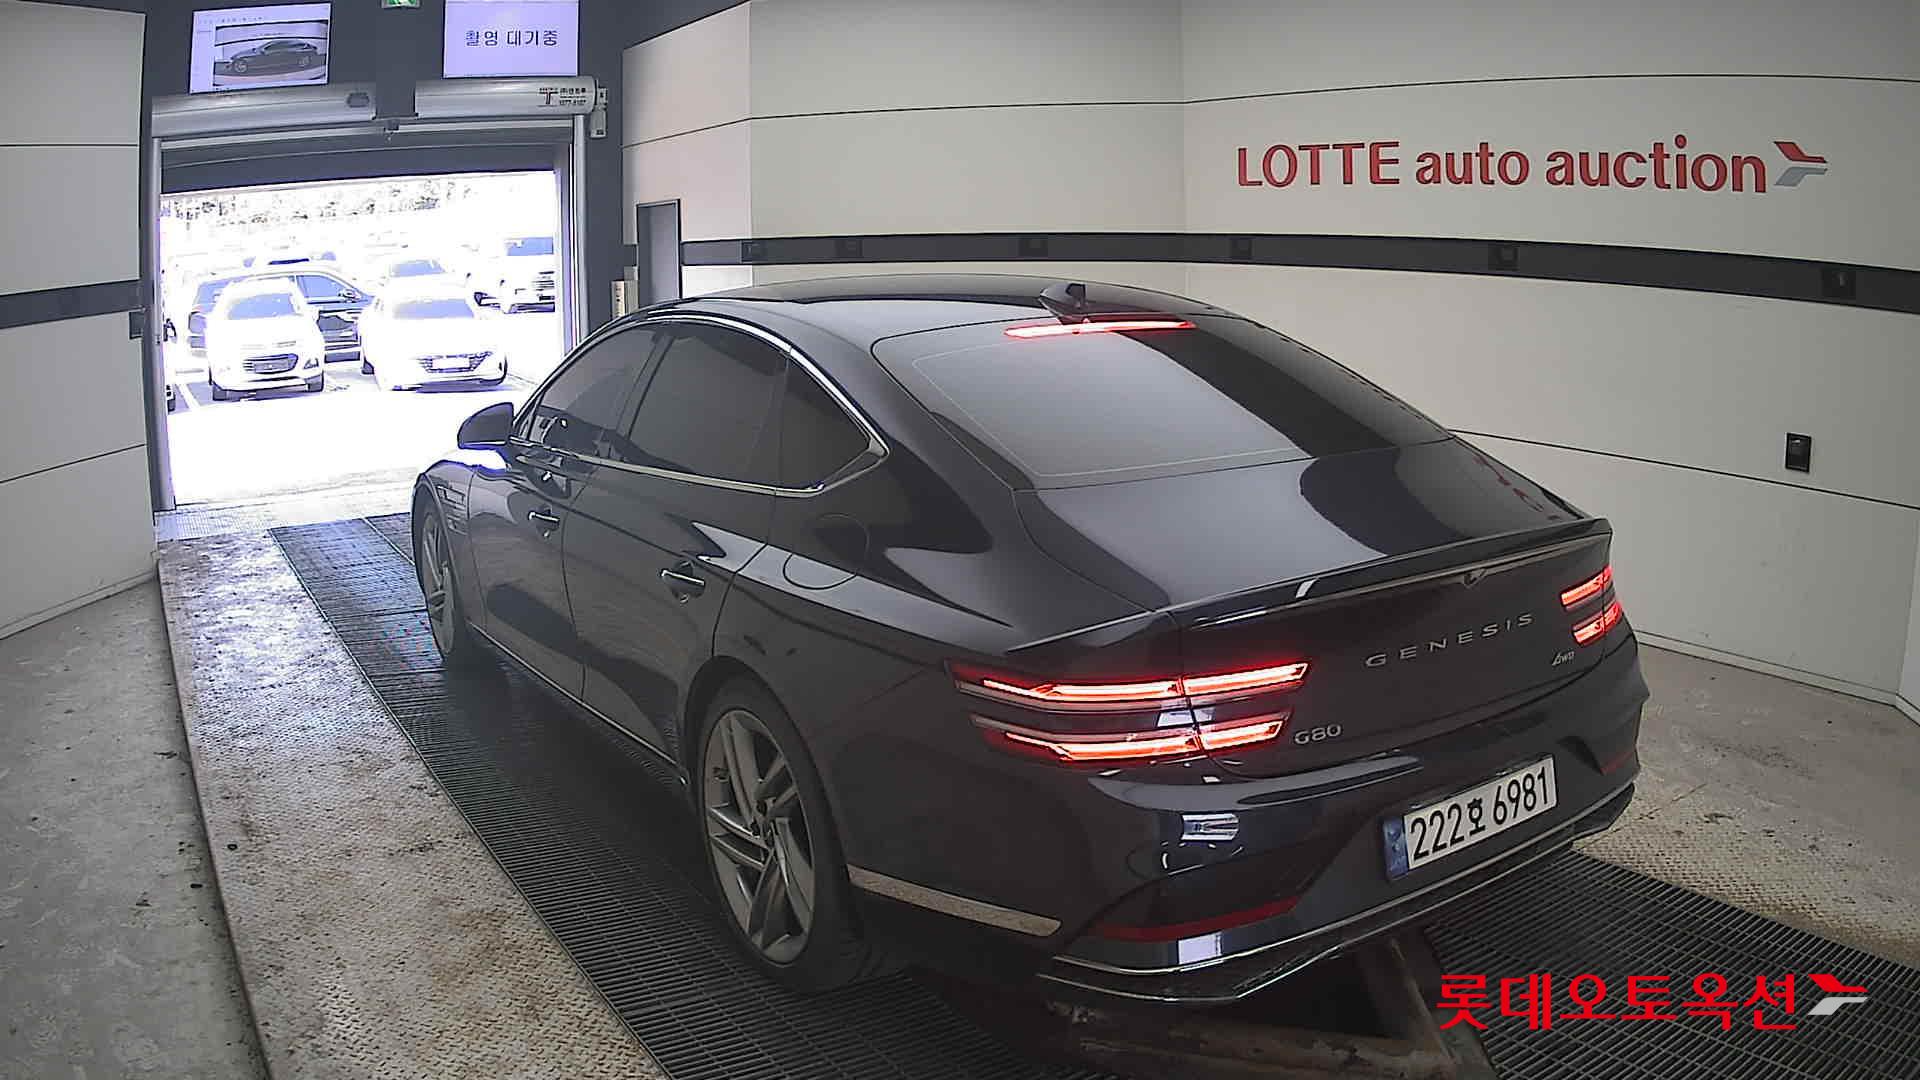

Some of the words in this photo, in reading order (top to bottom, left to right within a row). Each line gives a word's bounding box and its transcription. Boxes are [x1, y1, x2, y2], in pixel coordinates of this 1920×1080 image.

[506, 30, 558, 47] 대기중
[1237, 142, 1400, 187] LOTTE
[1415, 141, 1529, 185] auto
[1545, 134, 1767, 193] auction
[1365, 613, 1534, 668] GENESIS
[1294, 724, 1342, 745] G80
[1410, 798, 1486, 861] 222호
[1493, 766, 1549, 826] 6981
